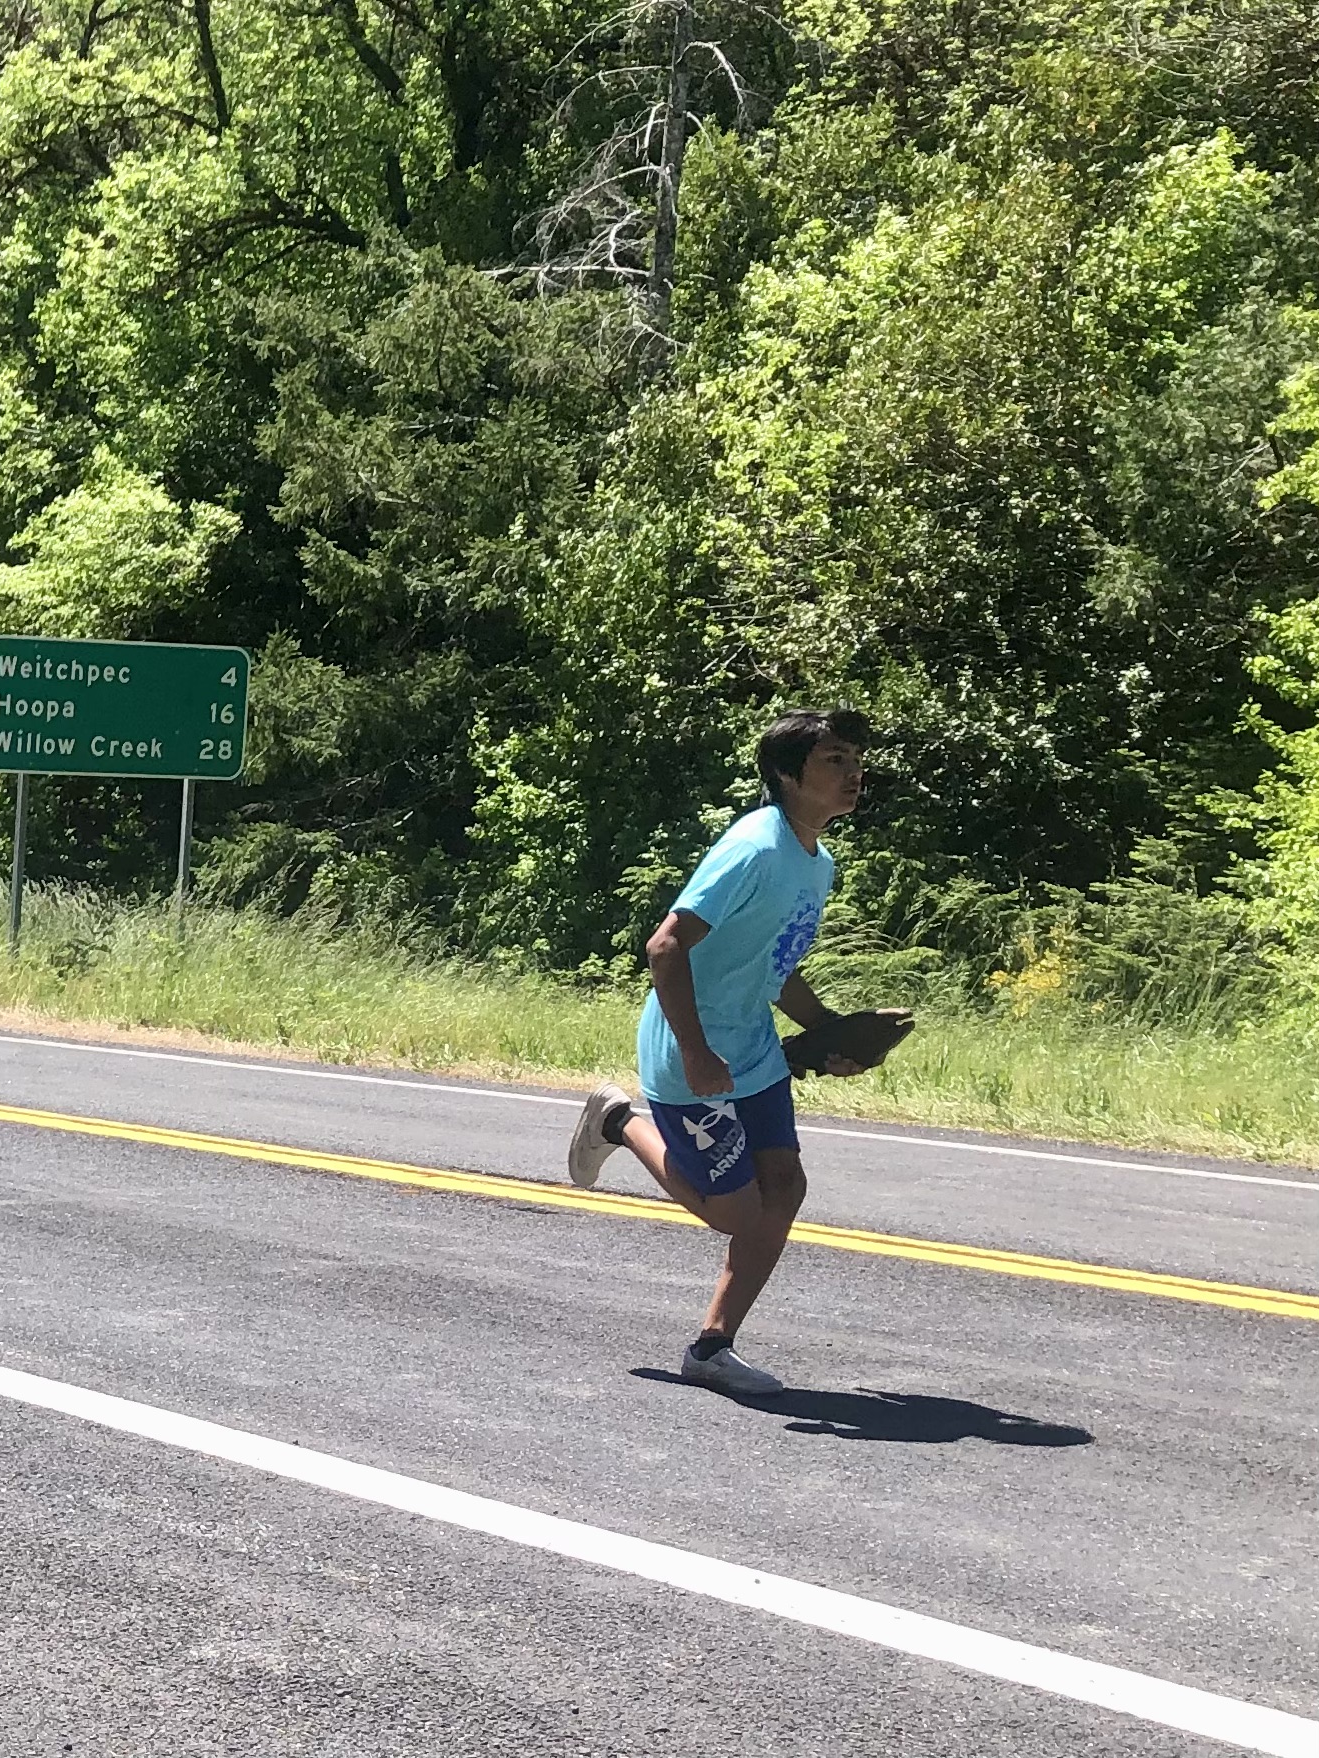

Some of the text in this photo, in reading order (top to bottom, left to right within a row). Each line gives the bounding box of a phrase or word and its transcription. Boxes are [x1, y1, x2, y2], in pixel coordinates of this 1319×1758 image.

[220, 666, 238, 687] 4
[210, 702, 235, 725] 16
[90, 735, 163, 759] Creek
[199, 739, 232, 761] 28
[709, 1127, 746, 1183] ARMO
